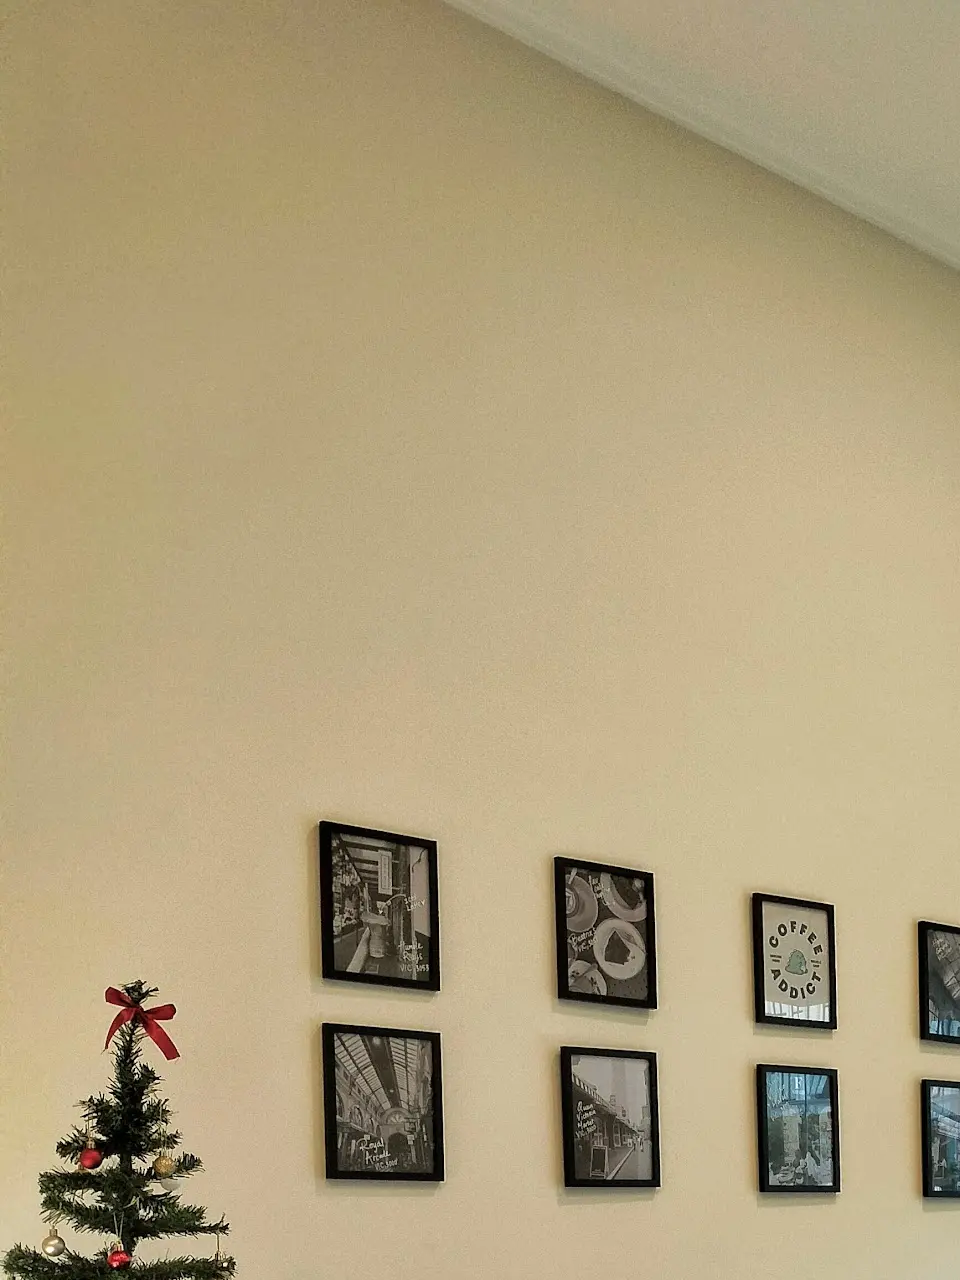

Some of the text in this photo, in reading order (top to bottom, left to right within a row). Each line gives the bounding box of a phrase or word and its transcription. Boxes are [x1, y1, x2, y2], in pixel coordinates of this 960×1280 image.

[769, 921, 823, 955] COFFEE
[771, 968, 822, 999] ADDICT
[356, 1137, 384, 1153] Royal
